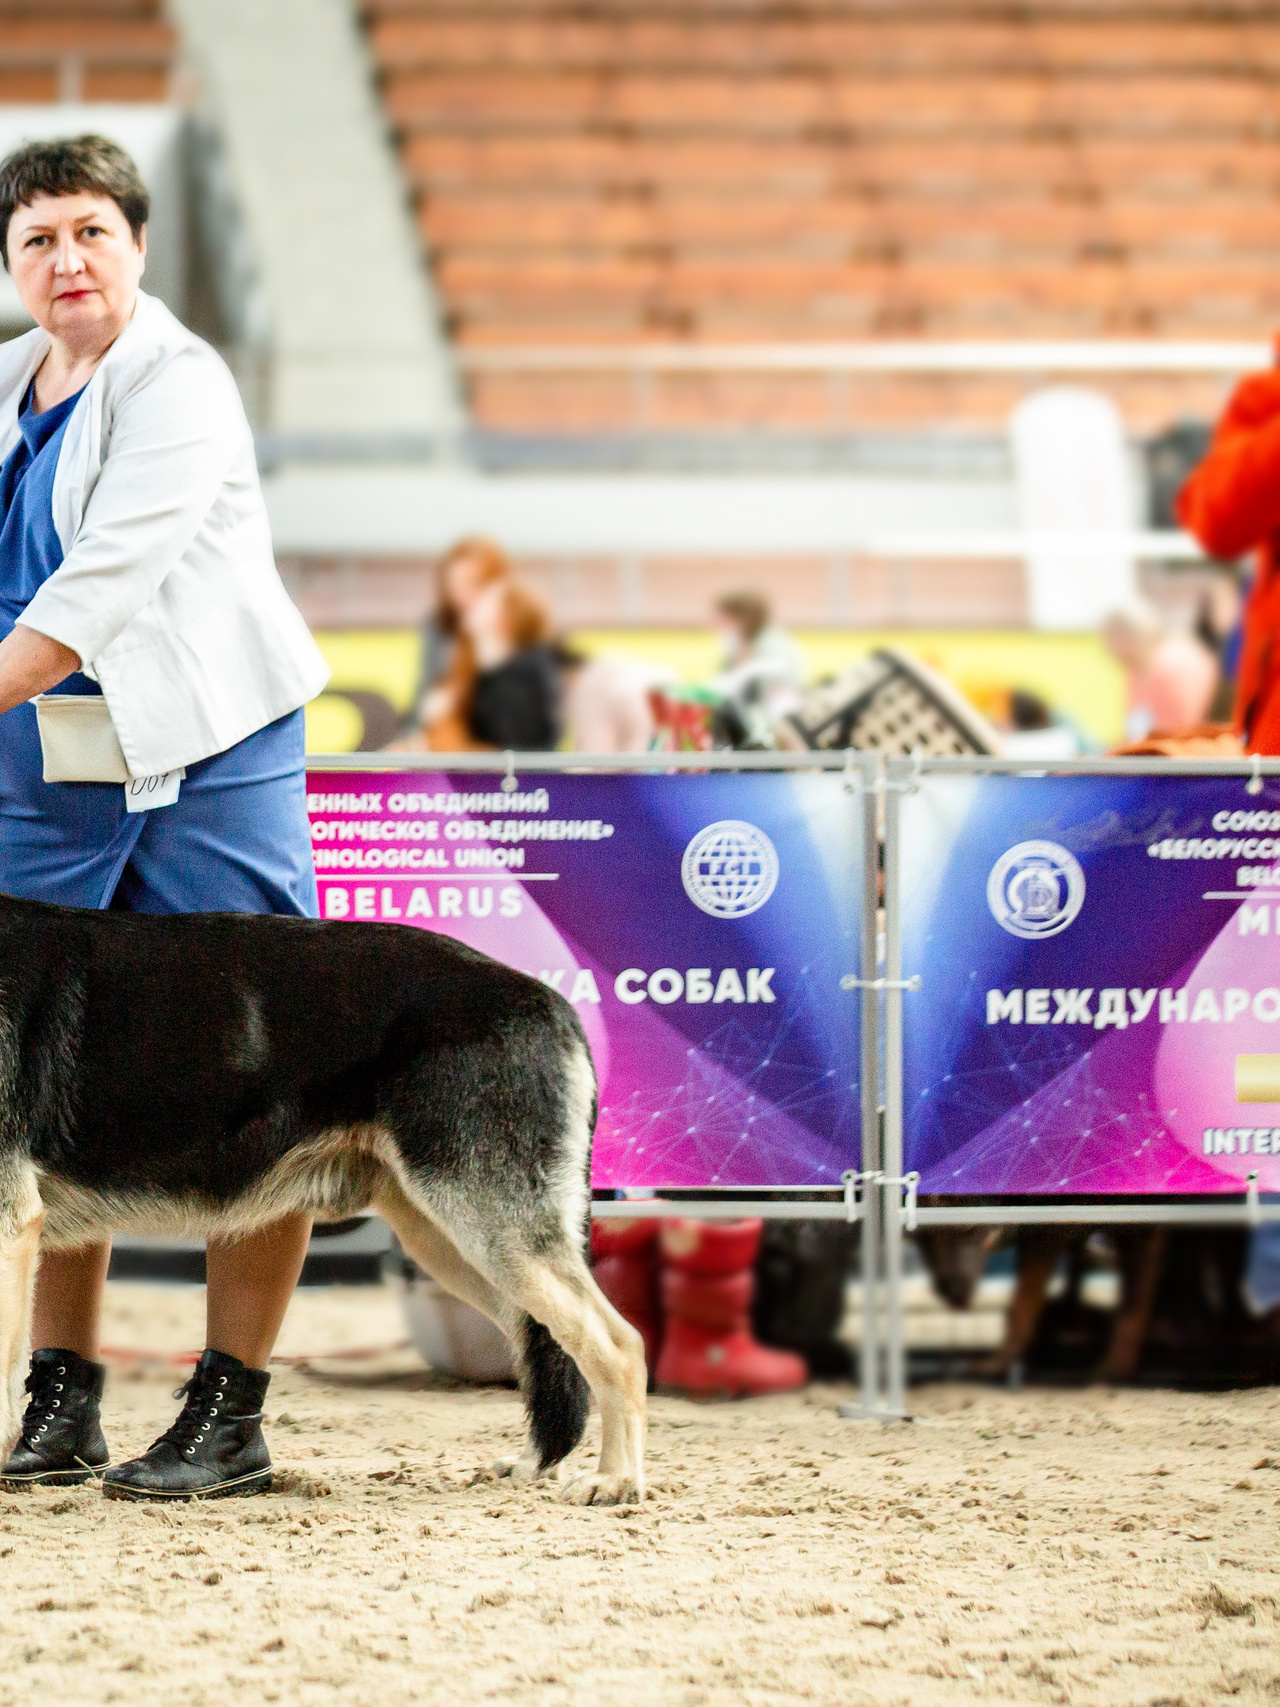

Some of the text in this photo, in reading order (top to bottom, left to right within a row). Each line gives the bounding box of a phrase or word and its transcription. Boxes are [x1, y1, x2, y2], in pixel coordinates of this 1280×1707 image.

[387, 788, 550, 816] ОБЪЕДИНЕНИЙ
[309, 820, 439, 842] ОГИЧЕСКОЕ
[454, 847, 525, 869] UNION
[325, 886, 524, 918] BELARUS
[613, 967, 777, 1005] СОБАК
